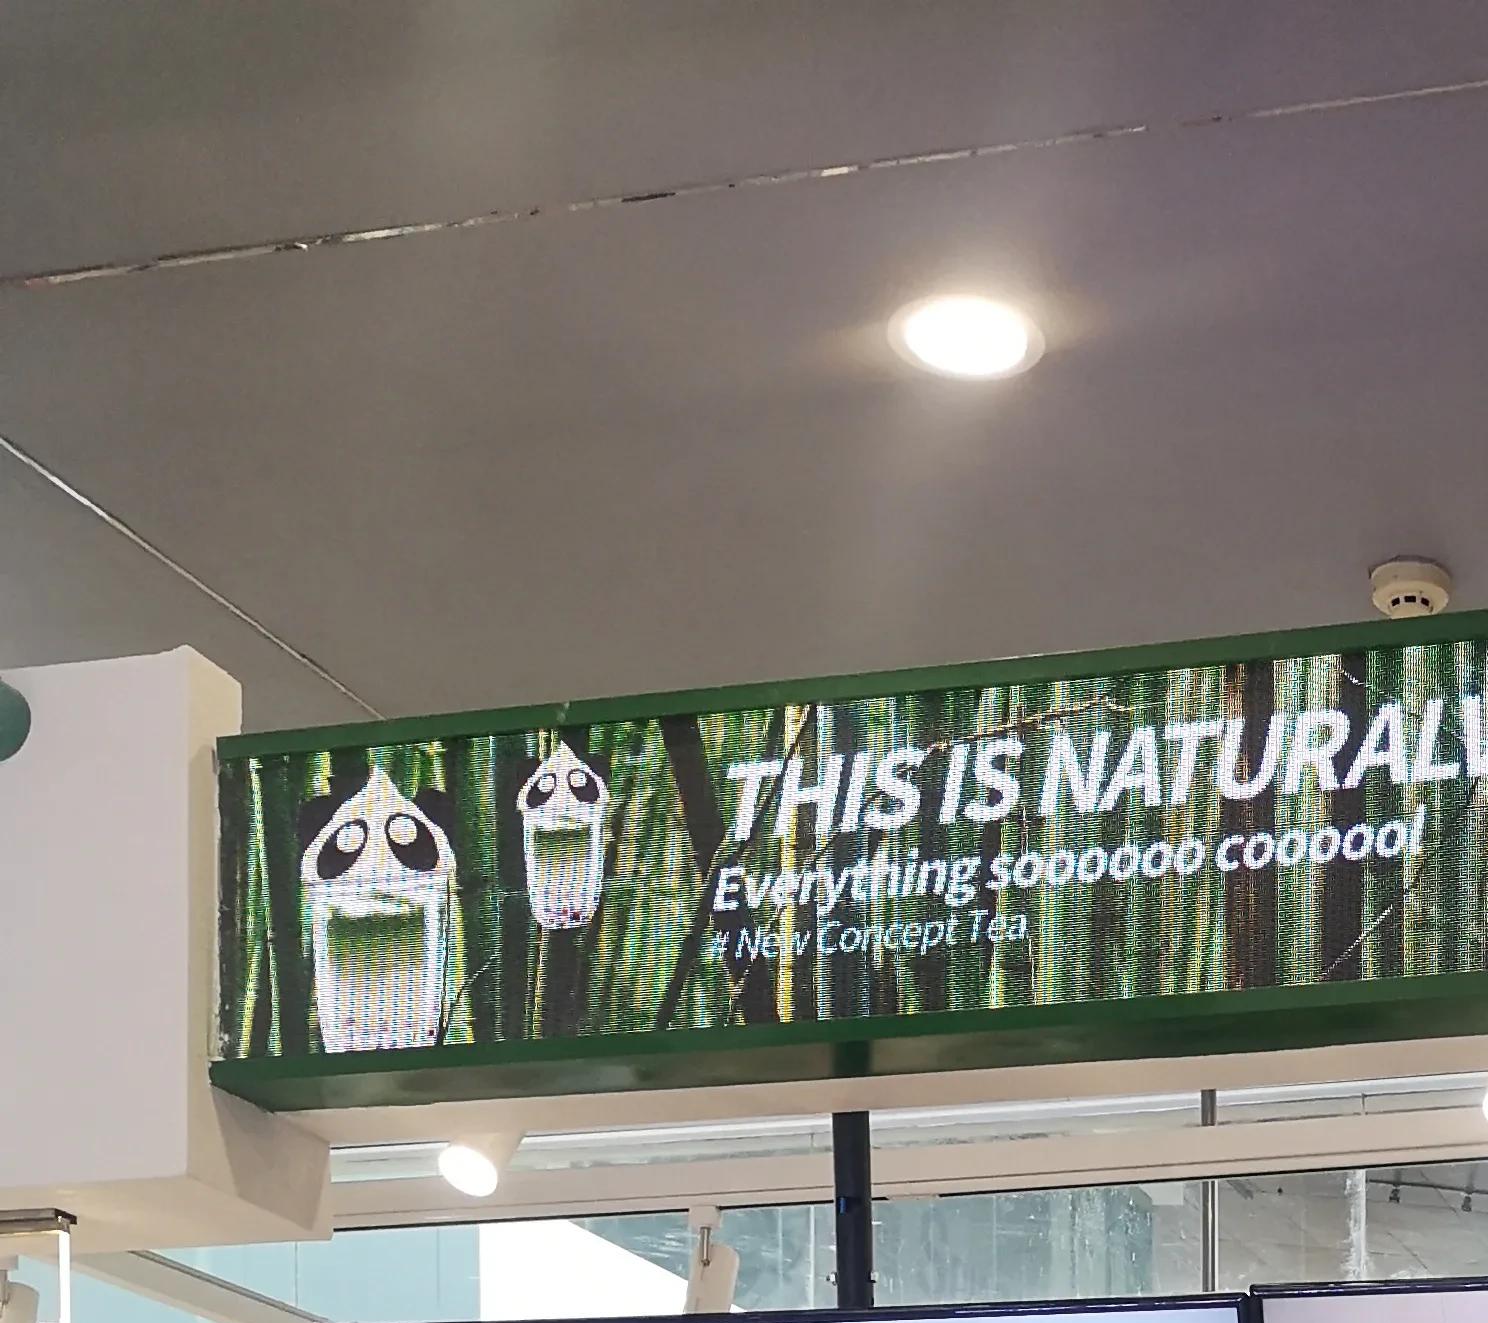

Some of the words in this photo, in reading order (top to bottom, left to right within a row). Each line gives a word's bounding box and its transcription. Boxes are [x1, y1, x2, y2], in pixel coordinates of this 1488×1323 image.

[724, 751, 922, 843] THIS
[938, 737, 1025, 825] IS
[713, 851, 979, 913] Everything
[735, 924, 808, 959] New
[816, 919, 957, 962] Concept
